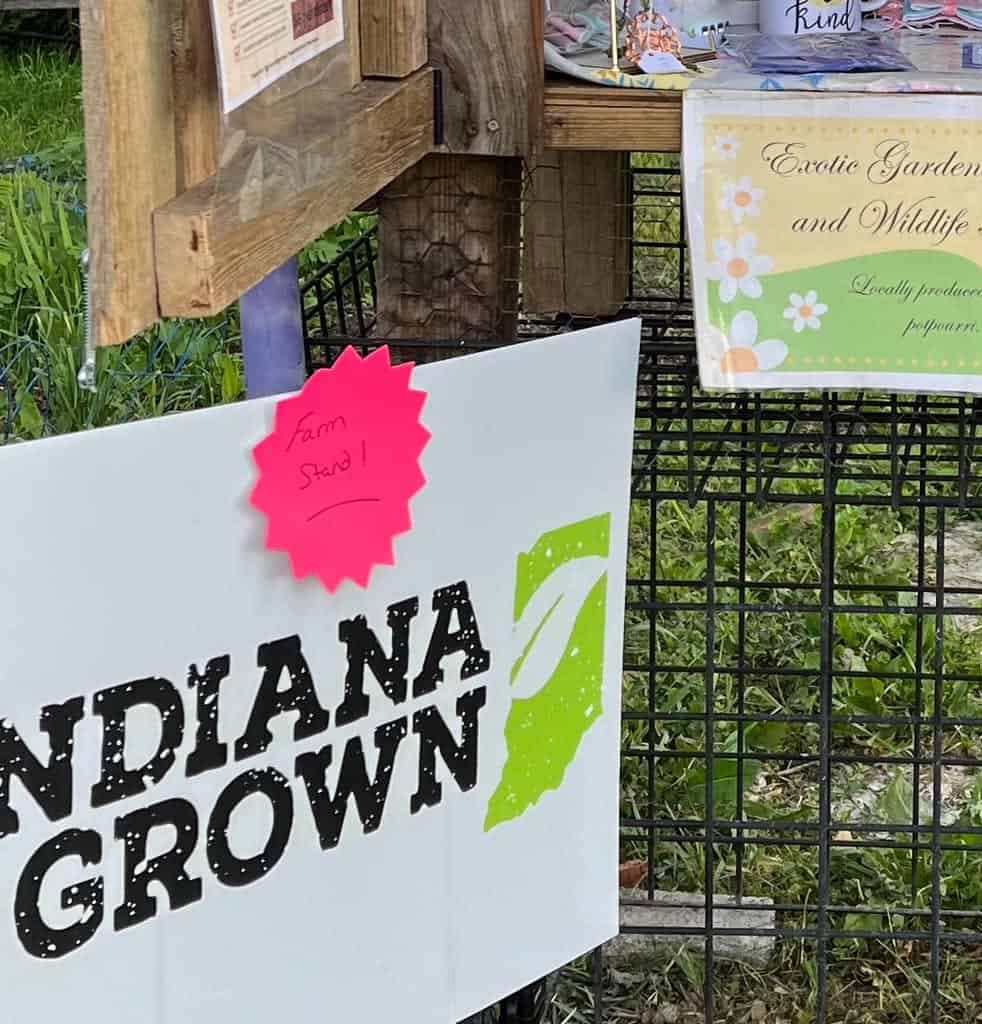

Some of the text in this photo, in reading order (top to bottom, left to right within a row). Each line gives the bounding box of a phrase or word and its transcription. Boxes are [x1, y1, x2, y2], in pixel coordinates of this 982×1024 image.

[760, 141, 859, 178] Exotic
[791, 207, 853, 234] and
[859, 196, 970, 247] Wildlife
[848, 273, 913, 301] Locally
[285, 411, 347, 453] Farm
[0, 580, 491, 838] NDIANA
[14, 686, 489, 959] GROWN
